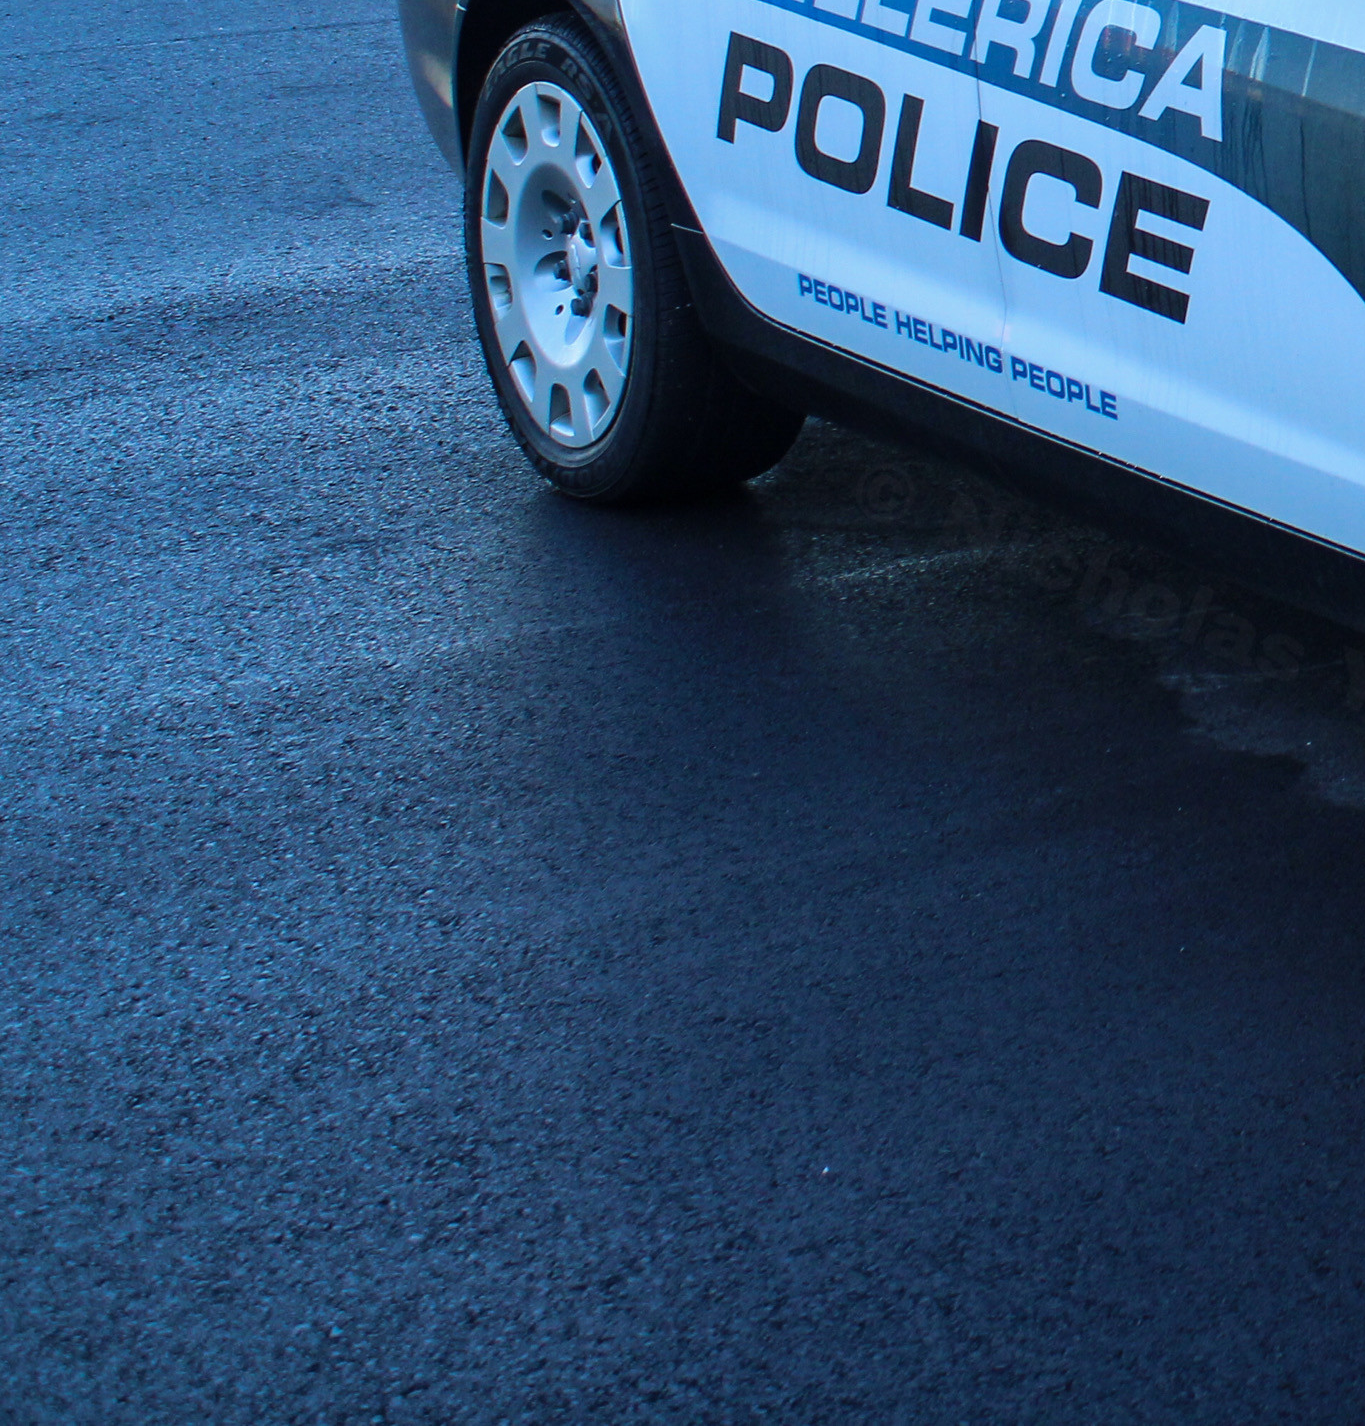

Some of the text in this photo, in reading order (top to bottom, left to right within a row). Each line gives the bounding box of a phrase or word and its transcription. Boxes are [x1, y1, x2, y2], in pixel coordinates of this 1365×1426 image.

[716, 31, 1210, 325] POLICE
[797, 273, 1118, 421] PEOPLE HELPING PEOPLE
